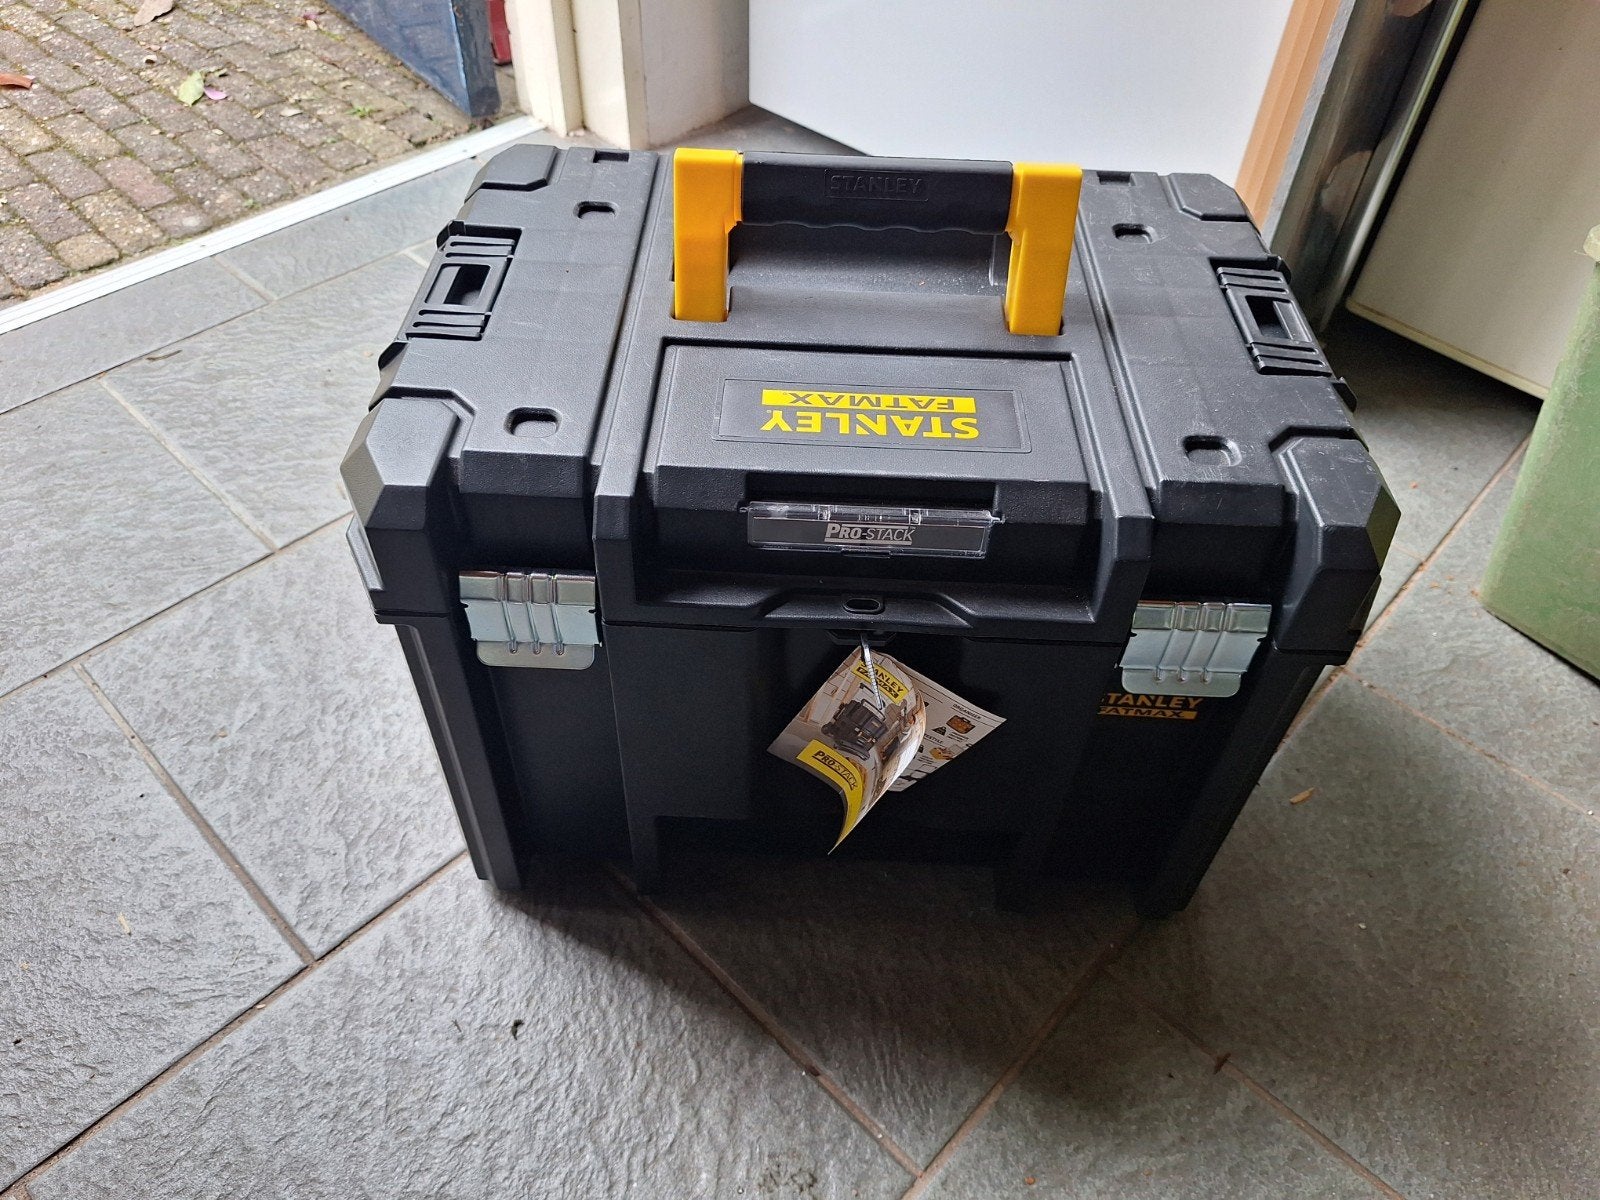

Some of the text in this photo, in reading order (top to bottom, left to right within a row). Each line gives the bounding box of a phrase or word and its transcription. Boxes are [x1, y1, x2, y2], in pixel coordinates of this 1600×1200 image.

[830, 174, 922, 194] STANLEY
[788, 392, 954, 411] FATMAX
[760, 409, 979, 439] STANLEY
[825, 522, 916, 542] PRO-STACK
[860, 662, 904, 693] ANLEY
[1102, 692, 1204, 708] TANLEY
